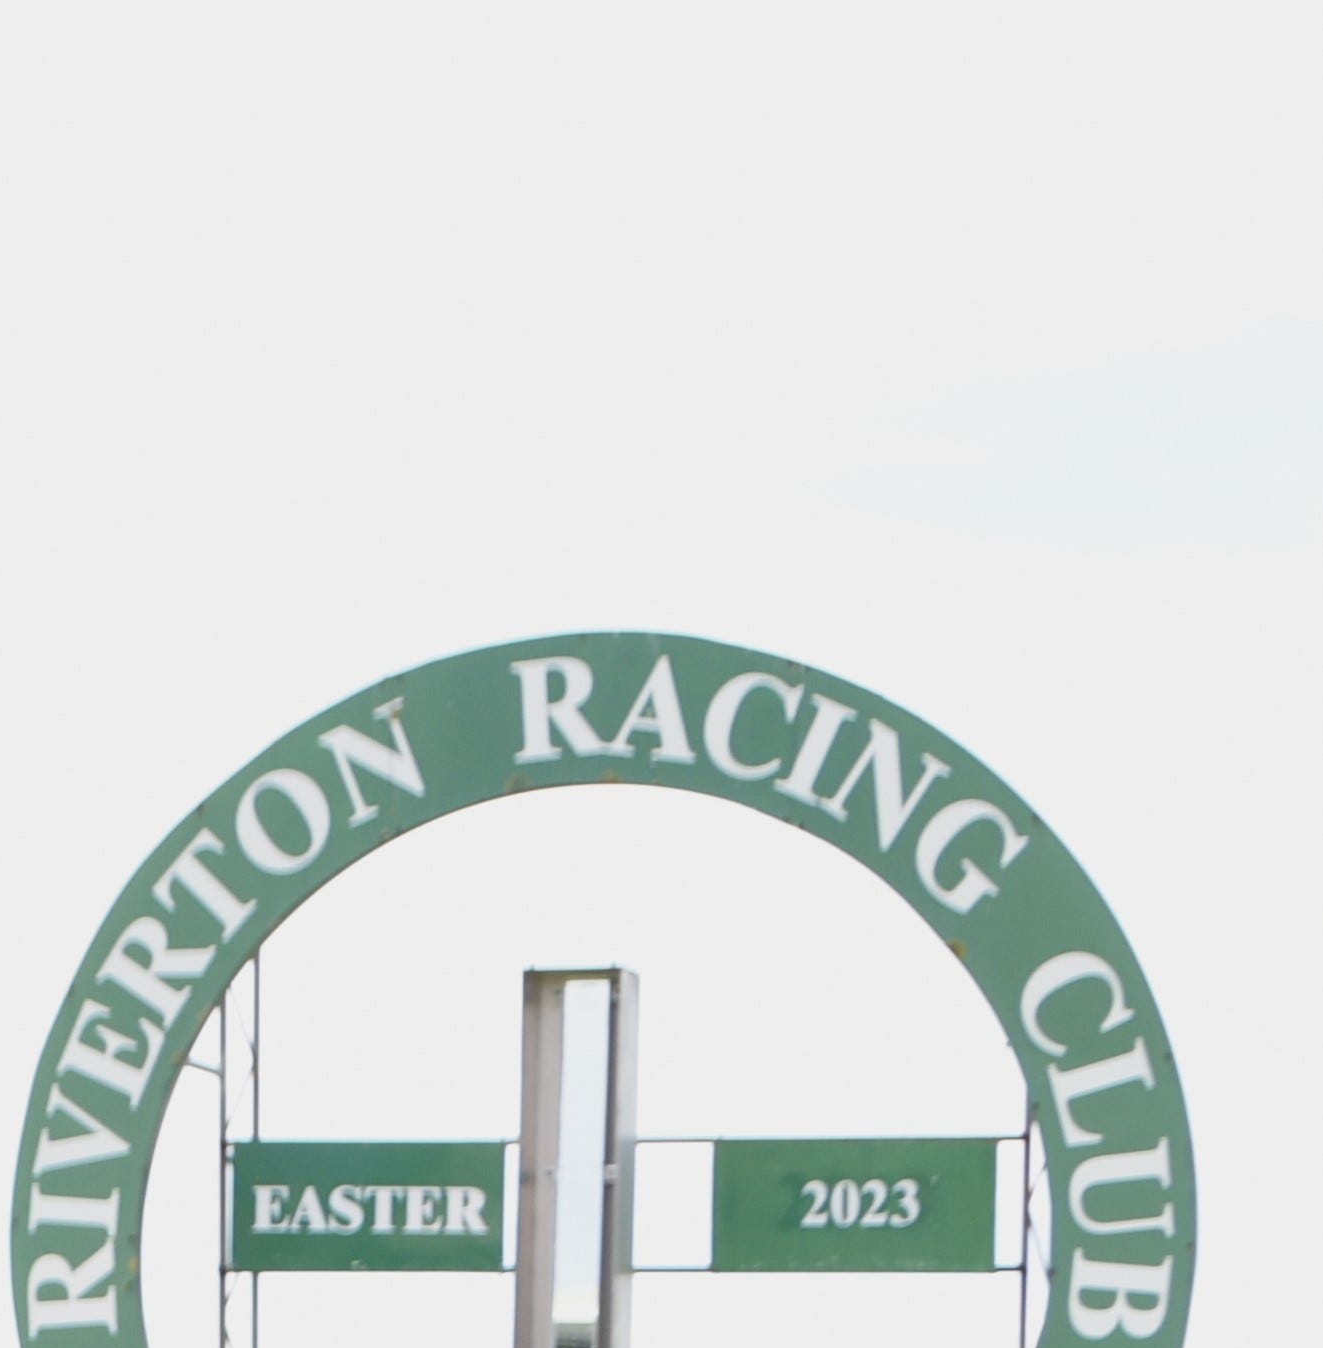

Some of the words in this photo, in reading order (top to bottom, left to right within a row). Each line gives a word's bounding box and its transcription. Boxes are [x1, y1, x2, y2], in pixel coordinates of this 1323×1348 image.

[27, 696, 425, 1340] RIVERTON
[510, 654, 1029, 914] RACING
[1020, 950, 1175, 1340] CLUB
[251, 1184, 489, 1235] EASTER
[800, 1178, 921, 1228] 2023
